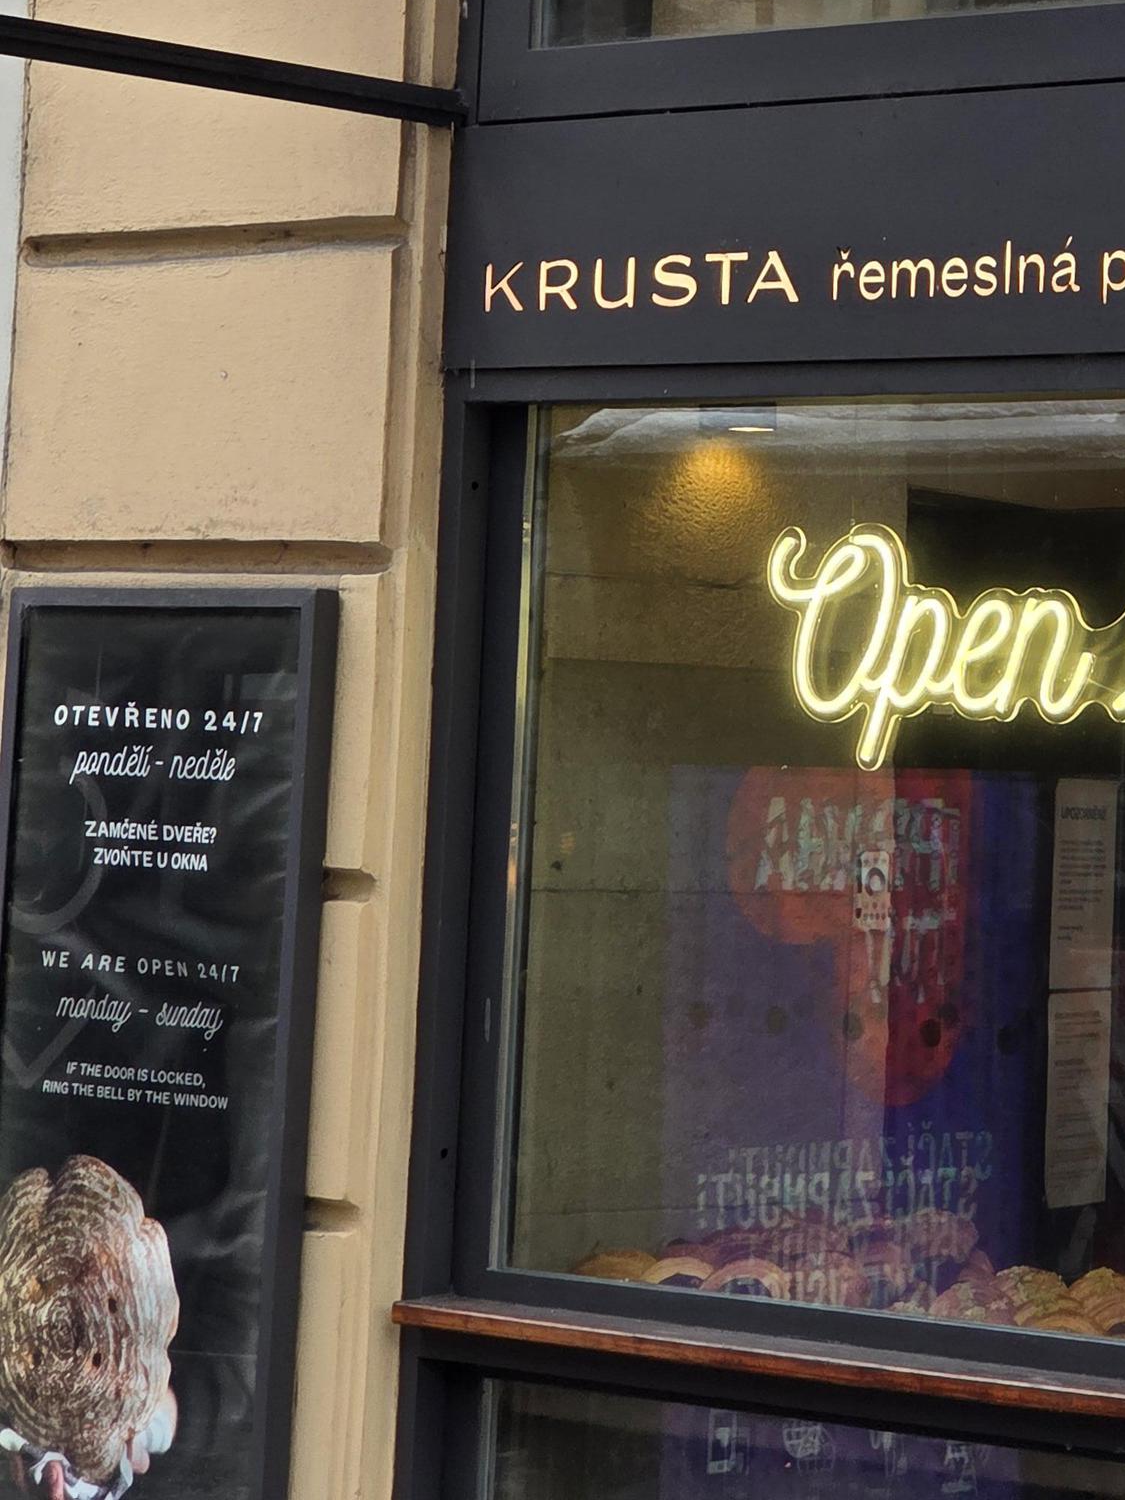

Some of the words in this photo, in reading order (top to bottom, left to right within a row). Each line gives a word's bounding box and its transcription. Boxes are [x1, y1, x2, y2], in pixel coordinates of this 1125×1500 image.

[484, 251, 800, 313] KRUSTA
[831, 237, 1080, 303] řemeslná
[768, 522, 1098, 772] Open
[53, 702, 190, 730] OTEVŘENO
[203, 710, 264, 734] 24/7
[68, 745, 153, 785] pondělí
[168, 749, 236, 781] neděle
[84, 818, 158, 841] ZAMČENÉ
[162, 822, 217, 844] DVEŘE?
[93, 846, 153, 868] ZVOŇTE
[157, 851, 167, 869] U
[171, 852, 208, 872] OKNA
[42, 950, 70, 968] WE
[80, 953, 126, 973] ARE
[137, 958, 188, 978] OPEN
[197, 963, 240, 983] 24/7
[56, 994, 132, 1033] monday
[155, 1001, 223, 1041] sunday
[66, 1061, 78, 1075] IF
[80, 1063, 102, 1078] THE
[103, 1065, 135, 1081] DOOR
[137, 1069, 149, 1082] IS
[150, 1070, 206, 1088] LOCKED,
[42, 1080, 69, 1094] RING
[72, 1083, 94, 1097] THE
[97, 1086, 125, 1100] BELL
[127, 1088, 142, 1102] BY
[145, 1090, 171, 1105] THE
[173, 1092, 229, 1109] WINDOW
